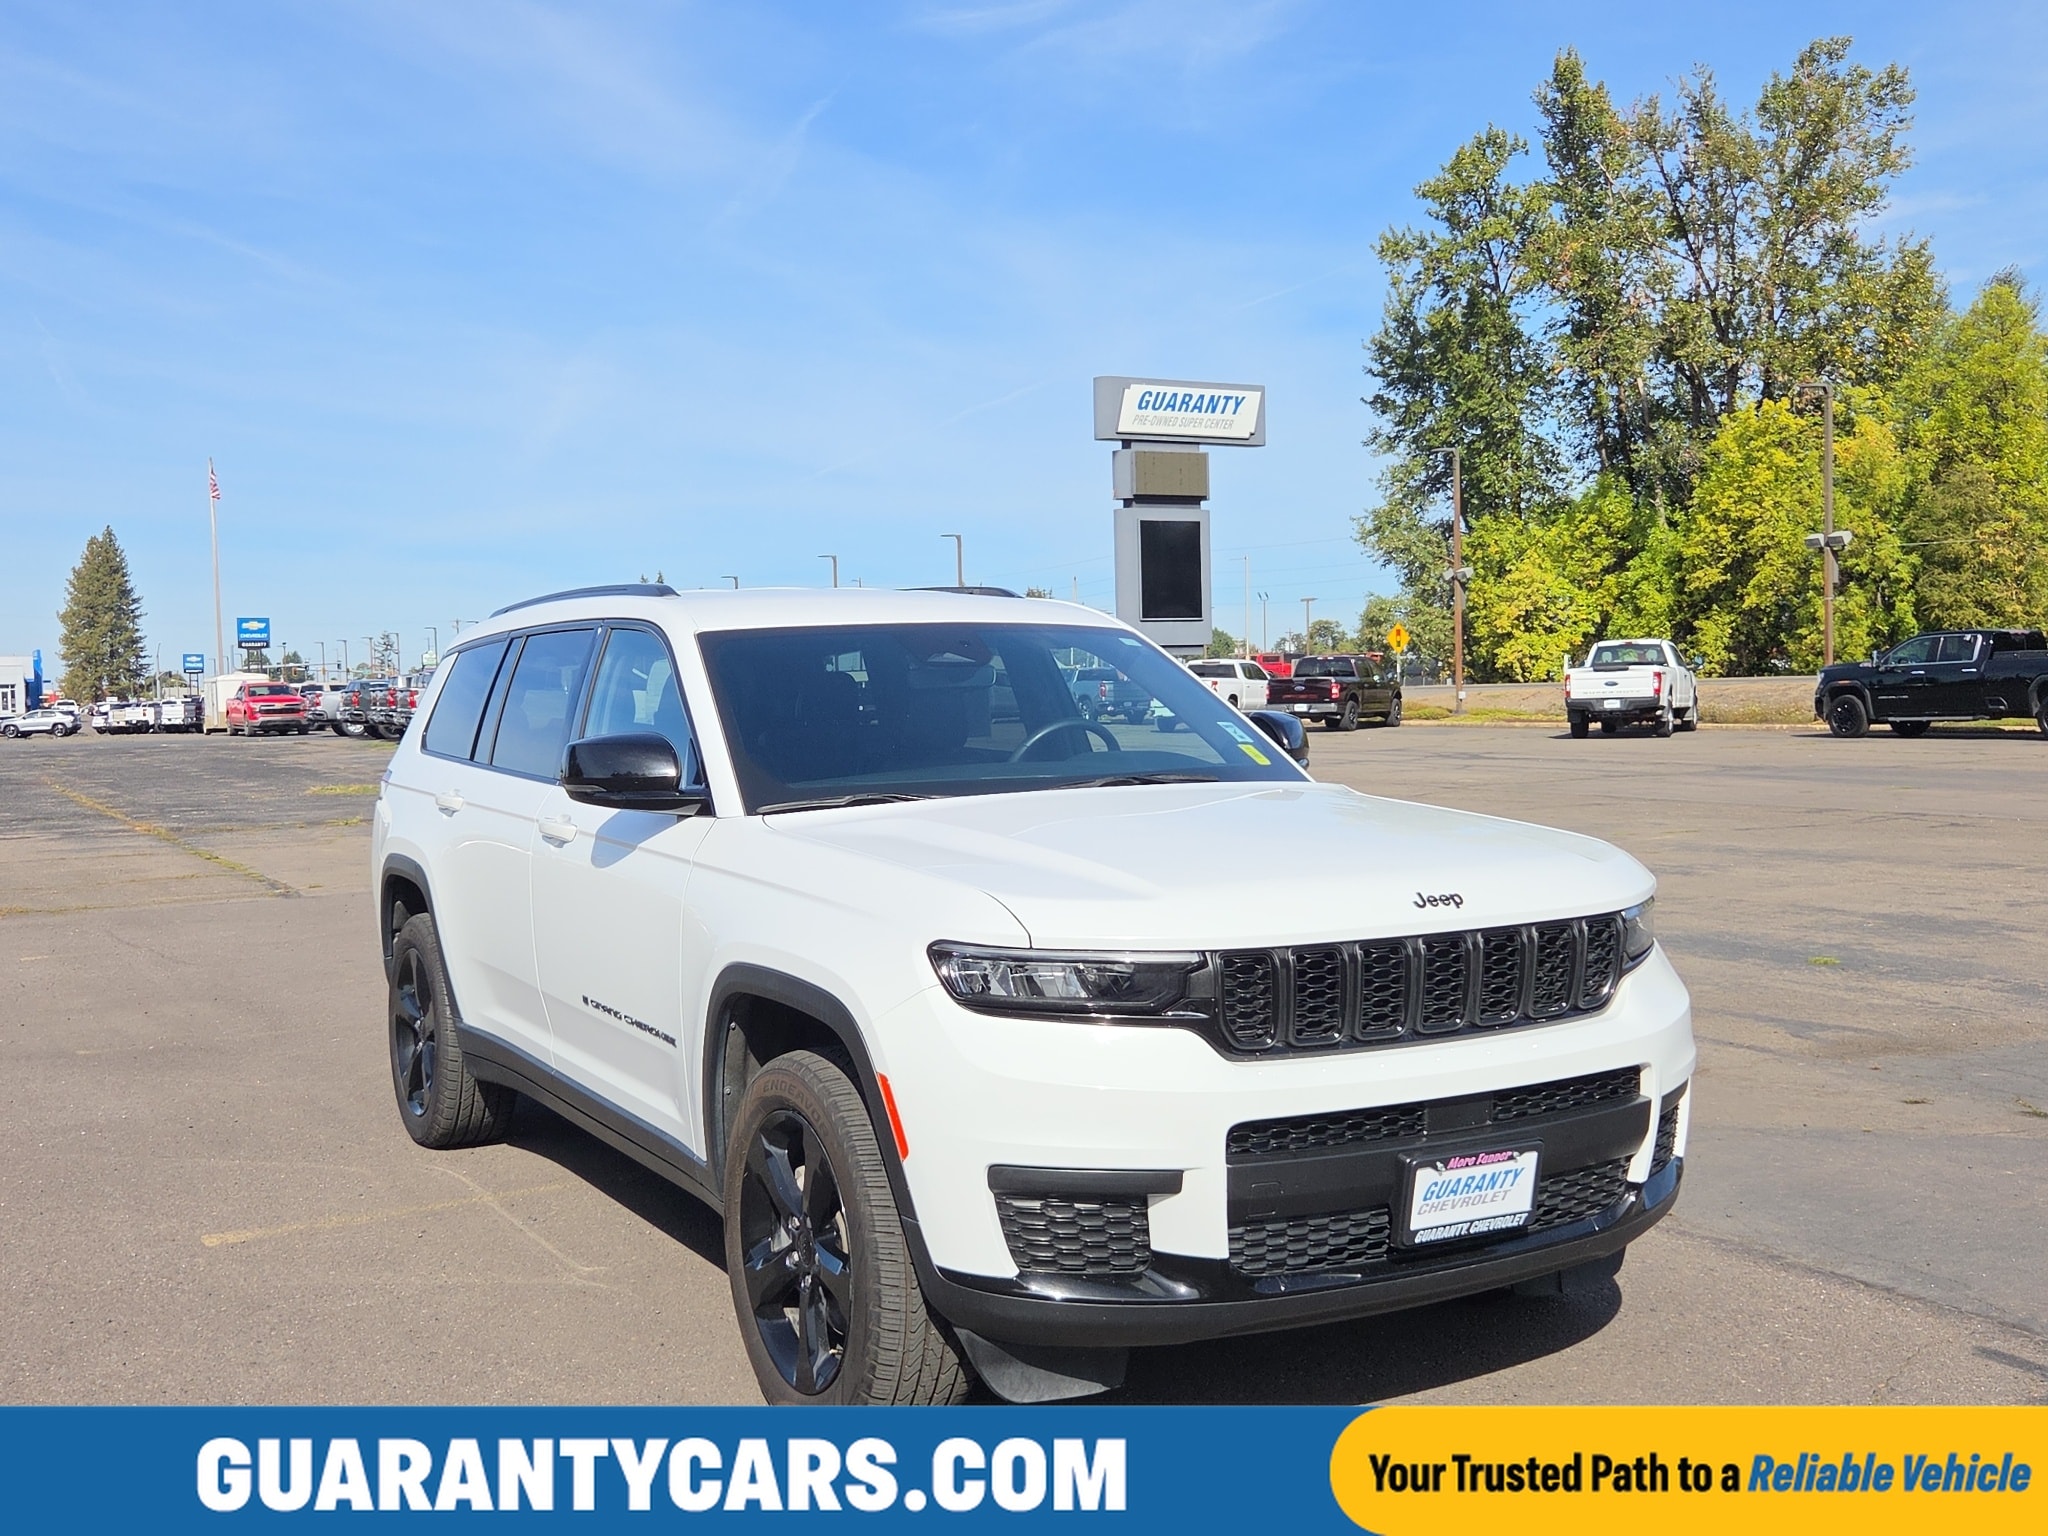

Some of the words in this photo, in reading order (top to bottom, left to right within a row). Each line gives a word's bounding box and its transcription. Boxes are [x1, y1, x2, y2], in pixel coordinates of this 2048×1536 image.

[1137, 391, 1246, 415] GUARANTY
[1132, 415, 1178, 427] PRE-OWNED
[1178, 416, 1204, 429] SUPER
[1204, 418, 1235, 430] CENTER
[1413, 892, 1464, 909] Jeep
[1447, 1156, 1476, 1169] More
[1422, 1167, 1526, 1202] GUARANTY
[1417, 1189, 1512, 1216] CHEVROLET
[1469, 1213, 1529, 1234] CHEVROLET
